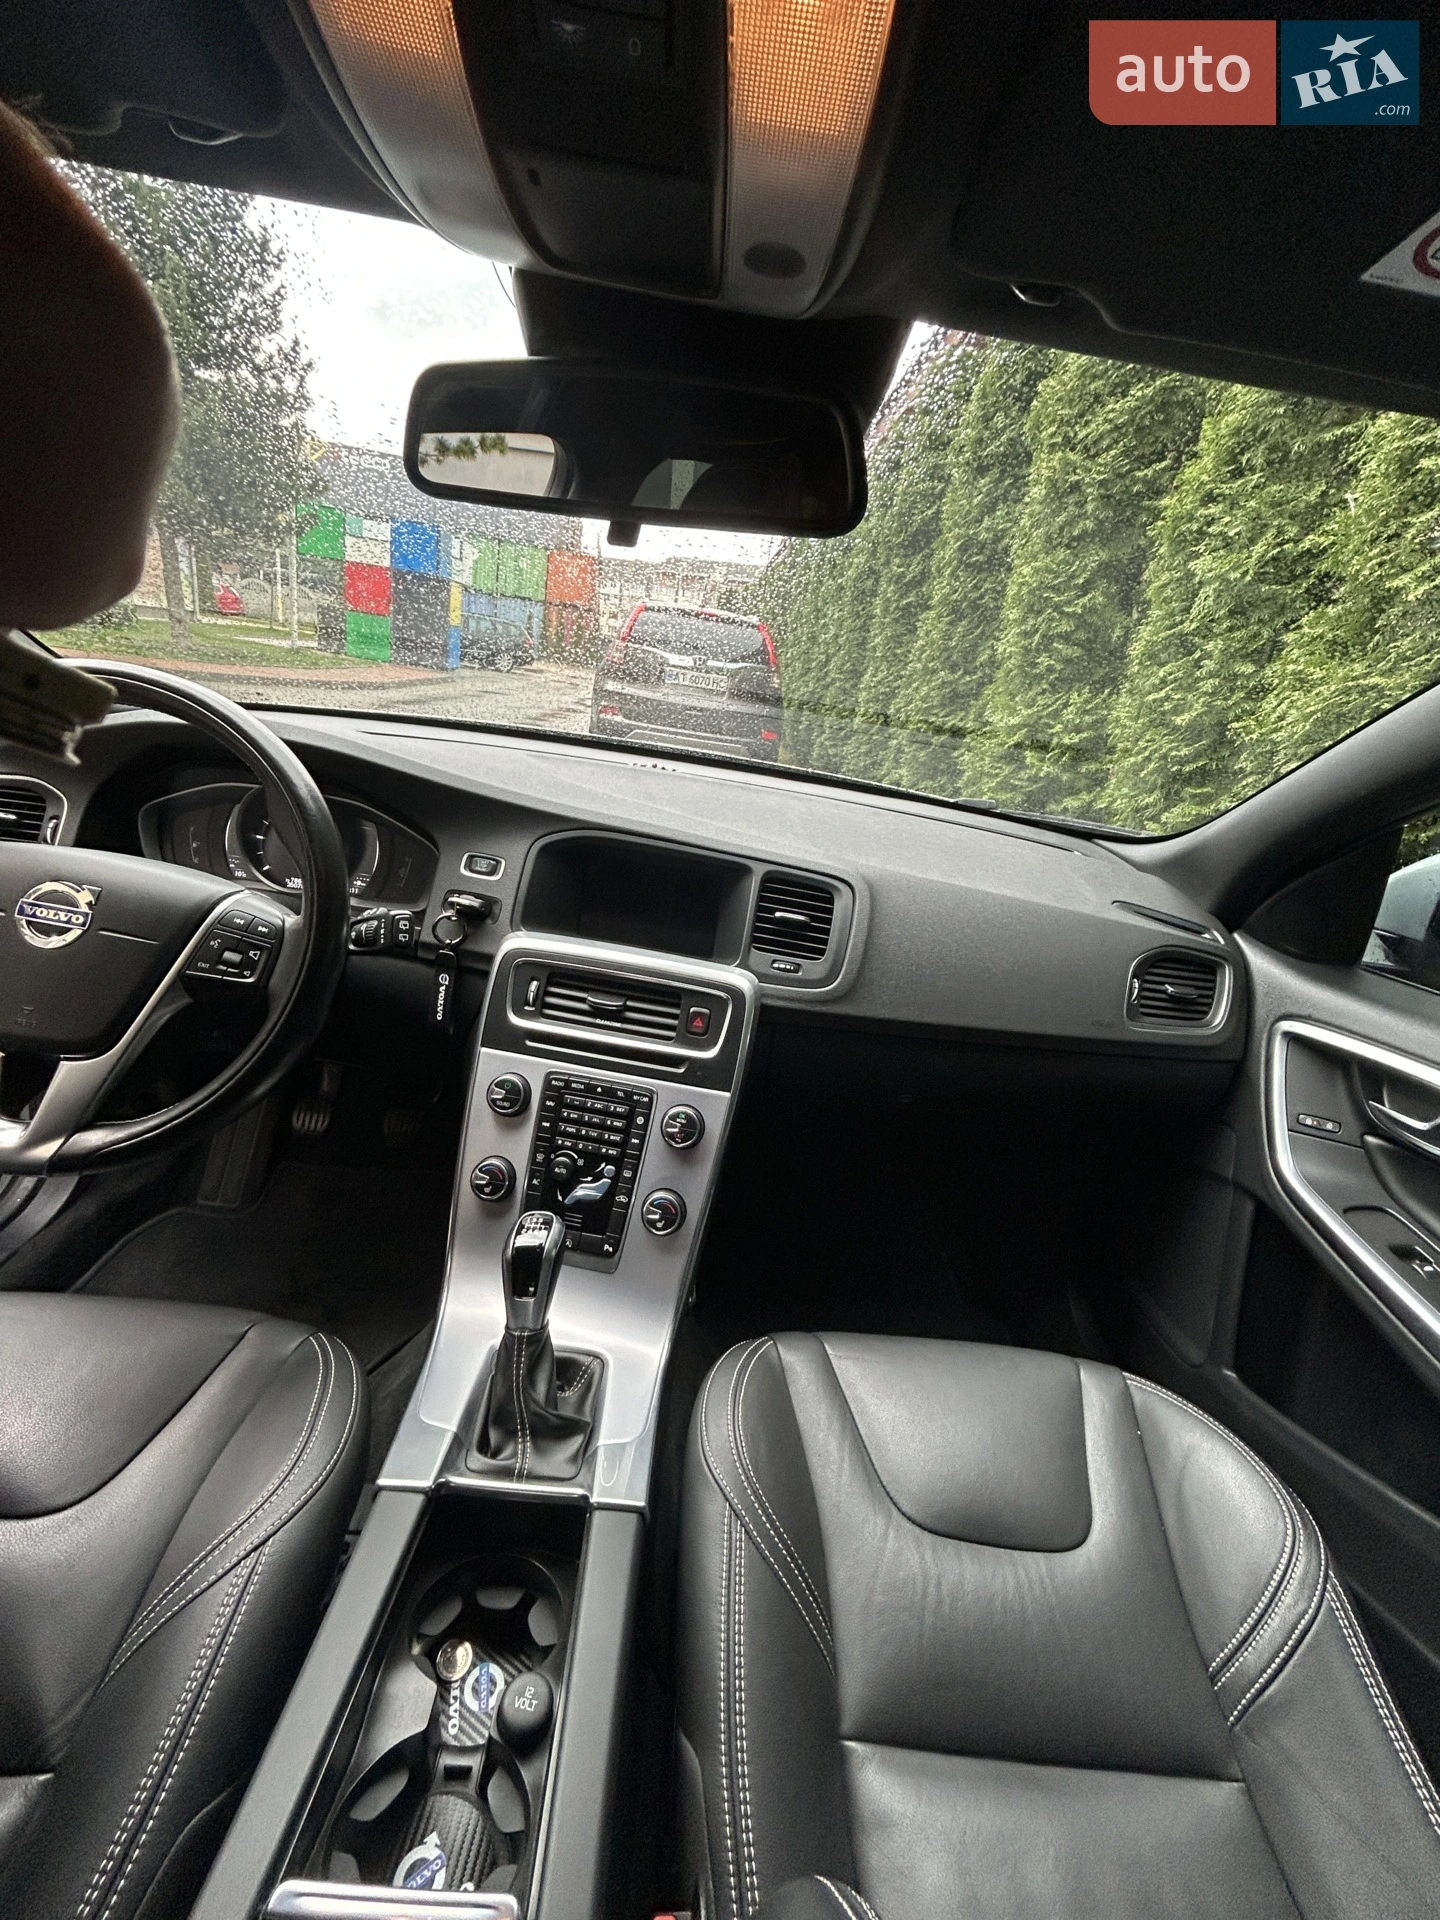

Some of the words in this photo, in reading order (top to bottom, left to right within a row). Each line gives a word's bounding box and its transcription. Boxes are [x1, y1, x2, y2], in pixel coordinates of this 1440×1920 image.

[23, 904, 84, 924] VOLVO
[197, 961, 210, 969] EXIT
[436, 985, 446, 1021] VOLVO
[571, 1082, 585, 1090] MEDIA
[480, 1666, 488, 1708] VOLVO
[524, 1685, 535, 1699] 12
[448, 1680, 460, 1736] LVO
[514, 1695, 539, 1712] VOLT
[407, 1859, 442, 1888] OLVO
